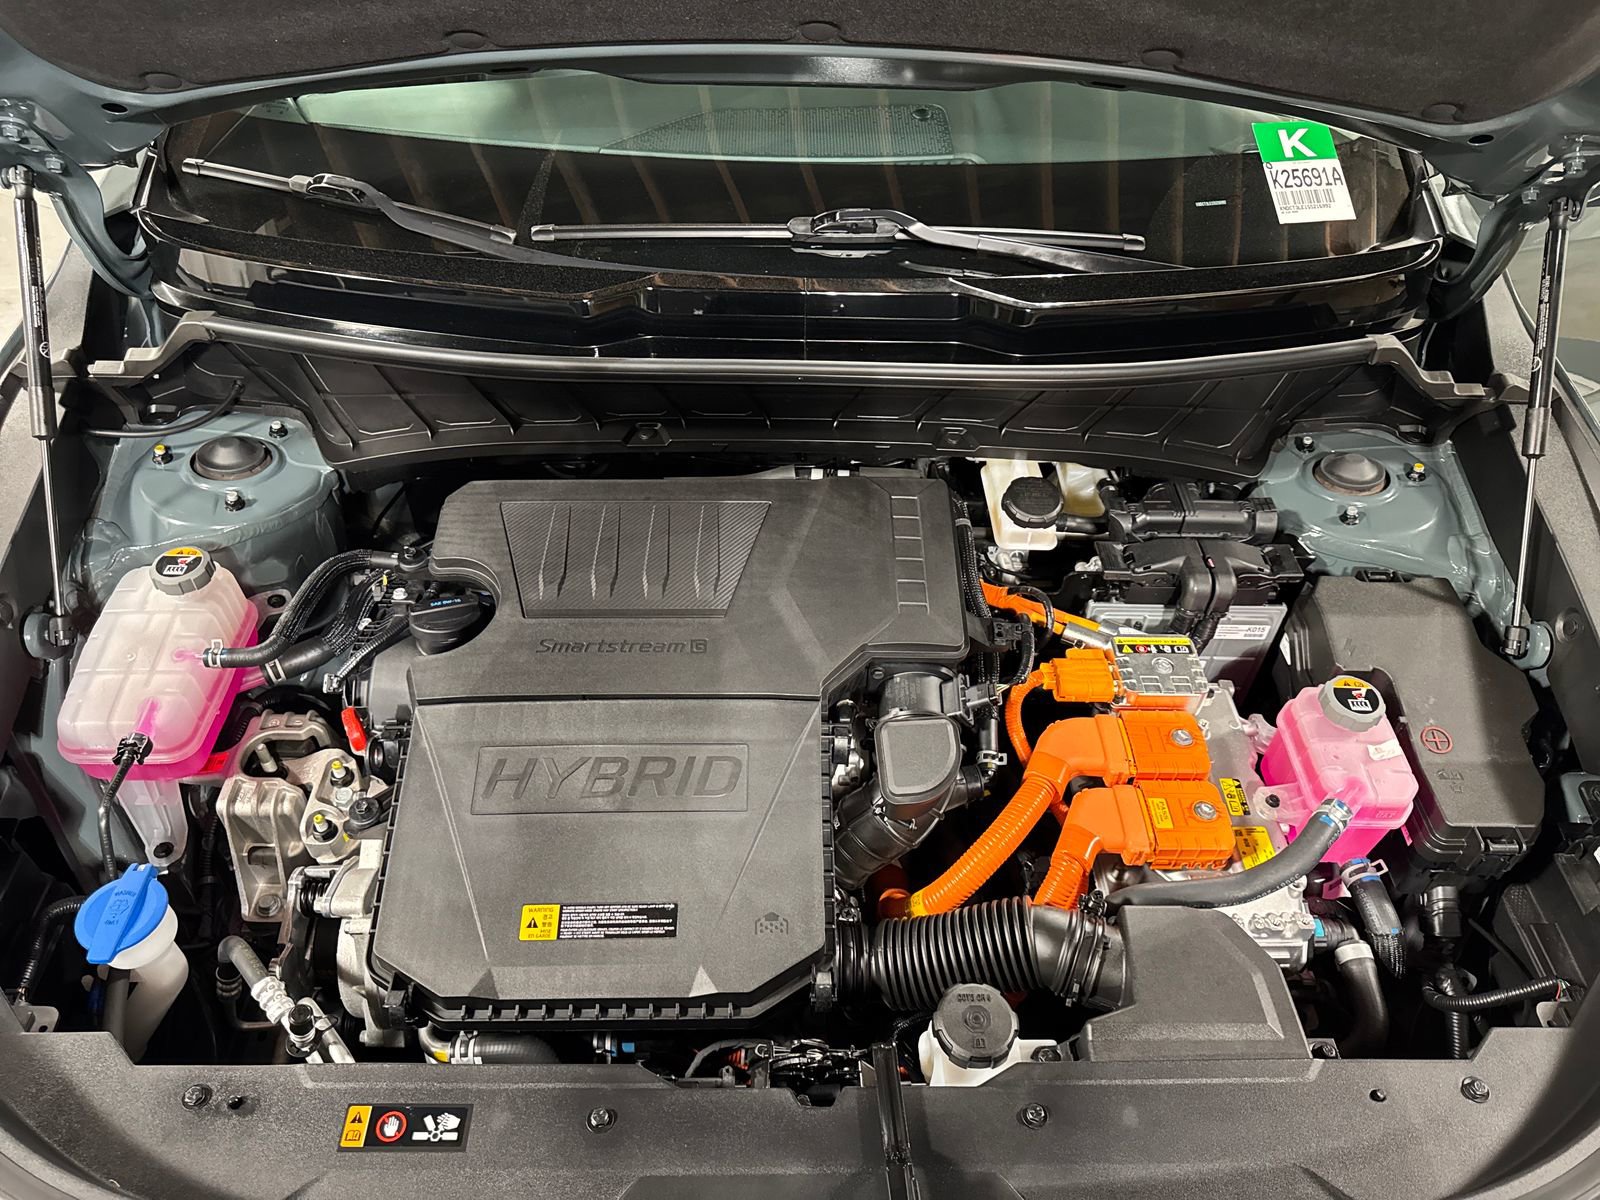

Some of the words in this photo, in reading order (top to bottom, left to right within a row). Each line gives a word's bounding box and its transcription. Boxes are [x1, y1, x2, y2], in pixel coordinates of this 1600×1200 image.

[1278, 128, 1318, 158] K
[1269, 166, 1344, 190] K25691A
[536, 638, 687, 654] Smartstream
[480, 755, 744, 800] HYBRID
